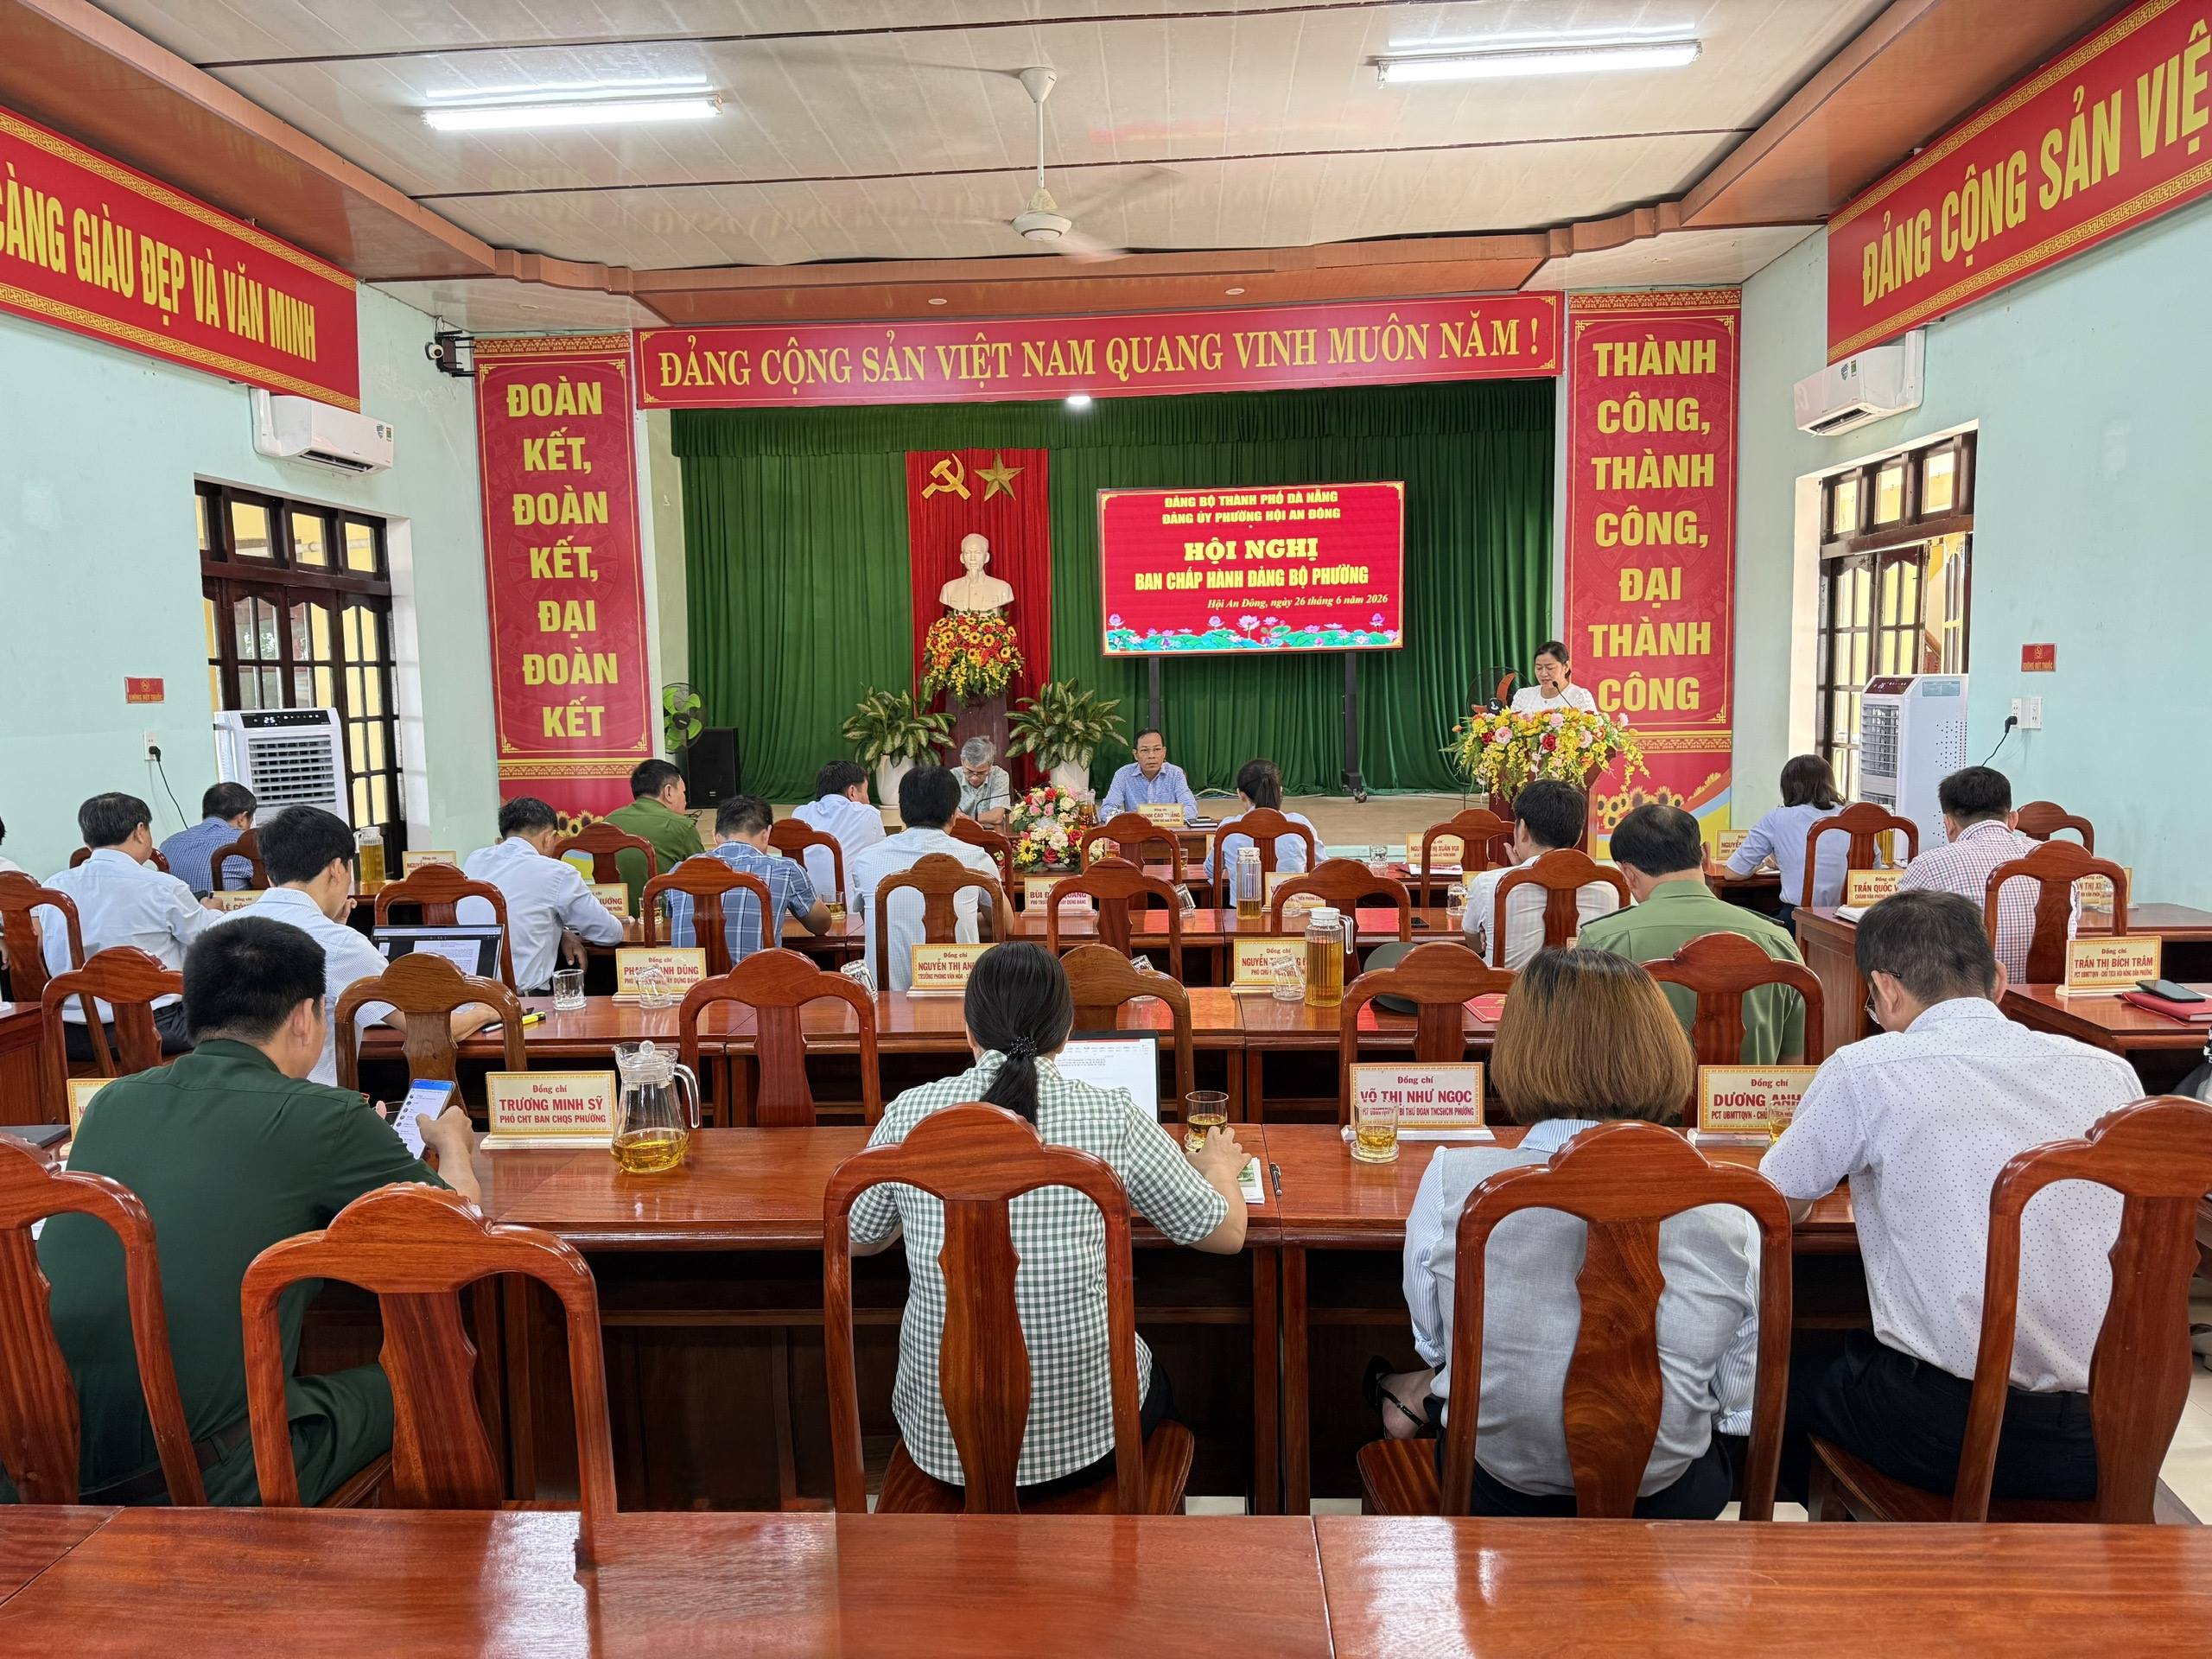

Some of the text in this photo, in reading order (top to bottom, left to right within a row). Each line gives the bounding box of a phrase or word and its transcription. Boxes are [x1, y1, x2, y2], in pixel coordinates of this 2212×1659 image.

[1863, 18, 2211, 308] ĐẢNG CỘNG SẢN VIỆ
[0, 161, 316, 363] ÀNG GIÀU ĐẸP VÀ VĂN MINH
[660, 311, 1539, 395] ĐẢNG CỘNG SẢN VIỆT NAM QUANG VINH MUÔN NĂM !
[1592, 334, 1717, 378] THÀNH
[506, 375, 602, 417] ĐOÀN
[1597, 391, 1711, 435] CÔNG,
[523, 426, 592, 474] KẾT,
[1591, 448, 1715, 490] THÀNH
[512, 484, 608, 525] ĐOÀN
[1164, 494, 1196, 508] ĐẢNG
[1198, 493, 1216, 509] BỘ
[1218, 493, 1257, 506] THÀNH
[1260, 490, 1285, 505] PHỐ
[1287, 491, 1303, 504] ĐÀ
[1161, 506, 1341, 524] ĐẢNG ỦY PHƯỜNG HỘI AN ĐÔNG
[1595, 505, 1709, 550] CÔNG,
[530, 534, 599, 582] KẾT,
[1184, 537, 1319, 565] HỘI NGHỊ
[1135, 563, 1370, 590] BAN CHẤP HÀNH ĐẢNG BỘ PHƯỜNG
[1618, 567, 1682, 608] ĐẠI
[1207, 594, 1389, 611] Hội An Đông, ngày 26 tháng 6 năm 2026
[537, 600, 596, 639] ĐẠI
[1588, 615, 1711, 658] THÀNH
[522, 646, 618, 686] ĐOÀN
[1598, 671, 1700, 712] CÔNG
[543, 695, 604, 738] KẾT
[677, 964, 699, 976] DŨNG
[918, 958, 947, 971] NGUYỄN
[1242, 953, 1268, 967] NGUYỄN
[2096, 958, 2110, 969] THỊ
[2111, 956, 2130, 968] BÍCH
[2132, 955, 2153, 967] TRÂM
[555, 1084, 568, 1093] chí
[1421, 1076, 1434, 1084] chí
[1776, 1078, 1789, 1087] chí
[499, 1095, 603, 1111] TRƯƠNG MINH SỸ
[1360, 1088, 1472, 1106] VÕ THỊ NHƯ NGỌC
[1399, 1105, 1405, 1116] BÍ
[1416, 1106, 1430, 1116] ĐOÀN
[1430, 1107, 1453, 1116] TNCSHCM
[1453, 1105, 1474, 1116] PHƯỜNG
[1713, 1091, 1766, 1107] DƯƠNG
[499, 1112, 607, 1125] PHÓ CHT BAN CHQS PHƯỜNG
[1711, 1110, 1721, 1120] PCT
